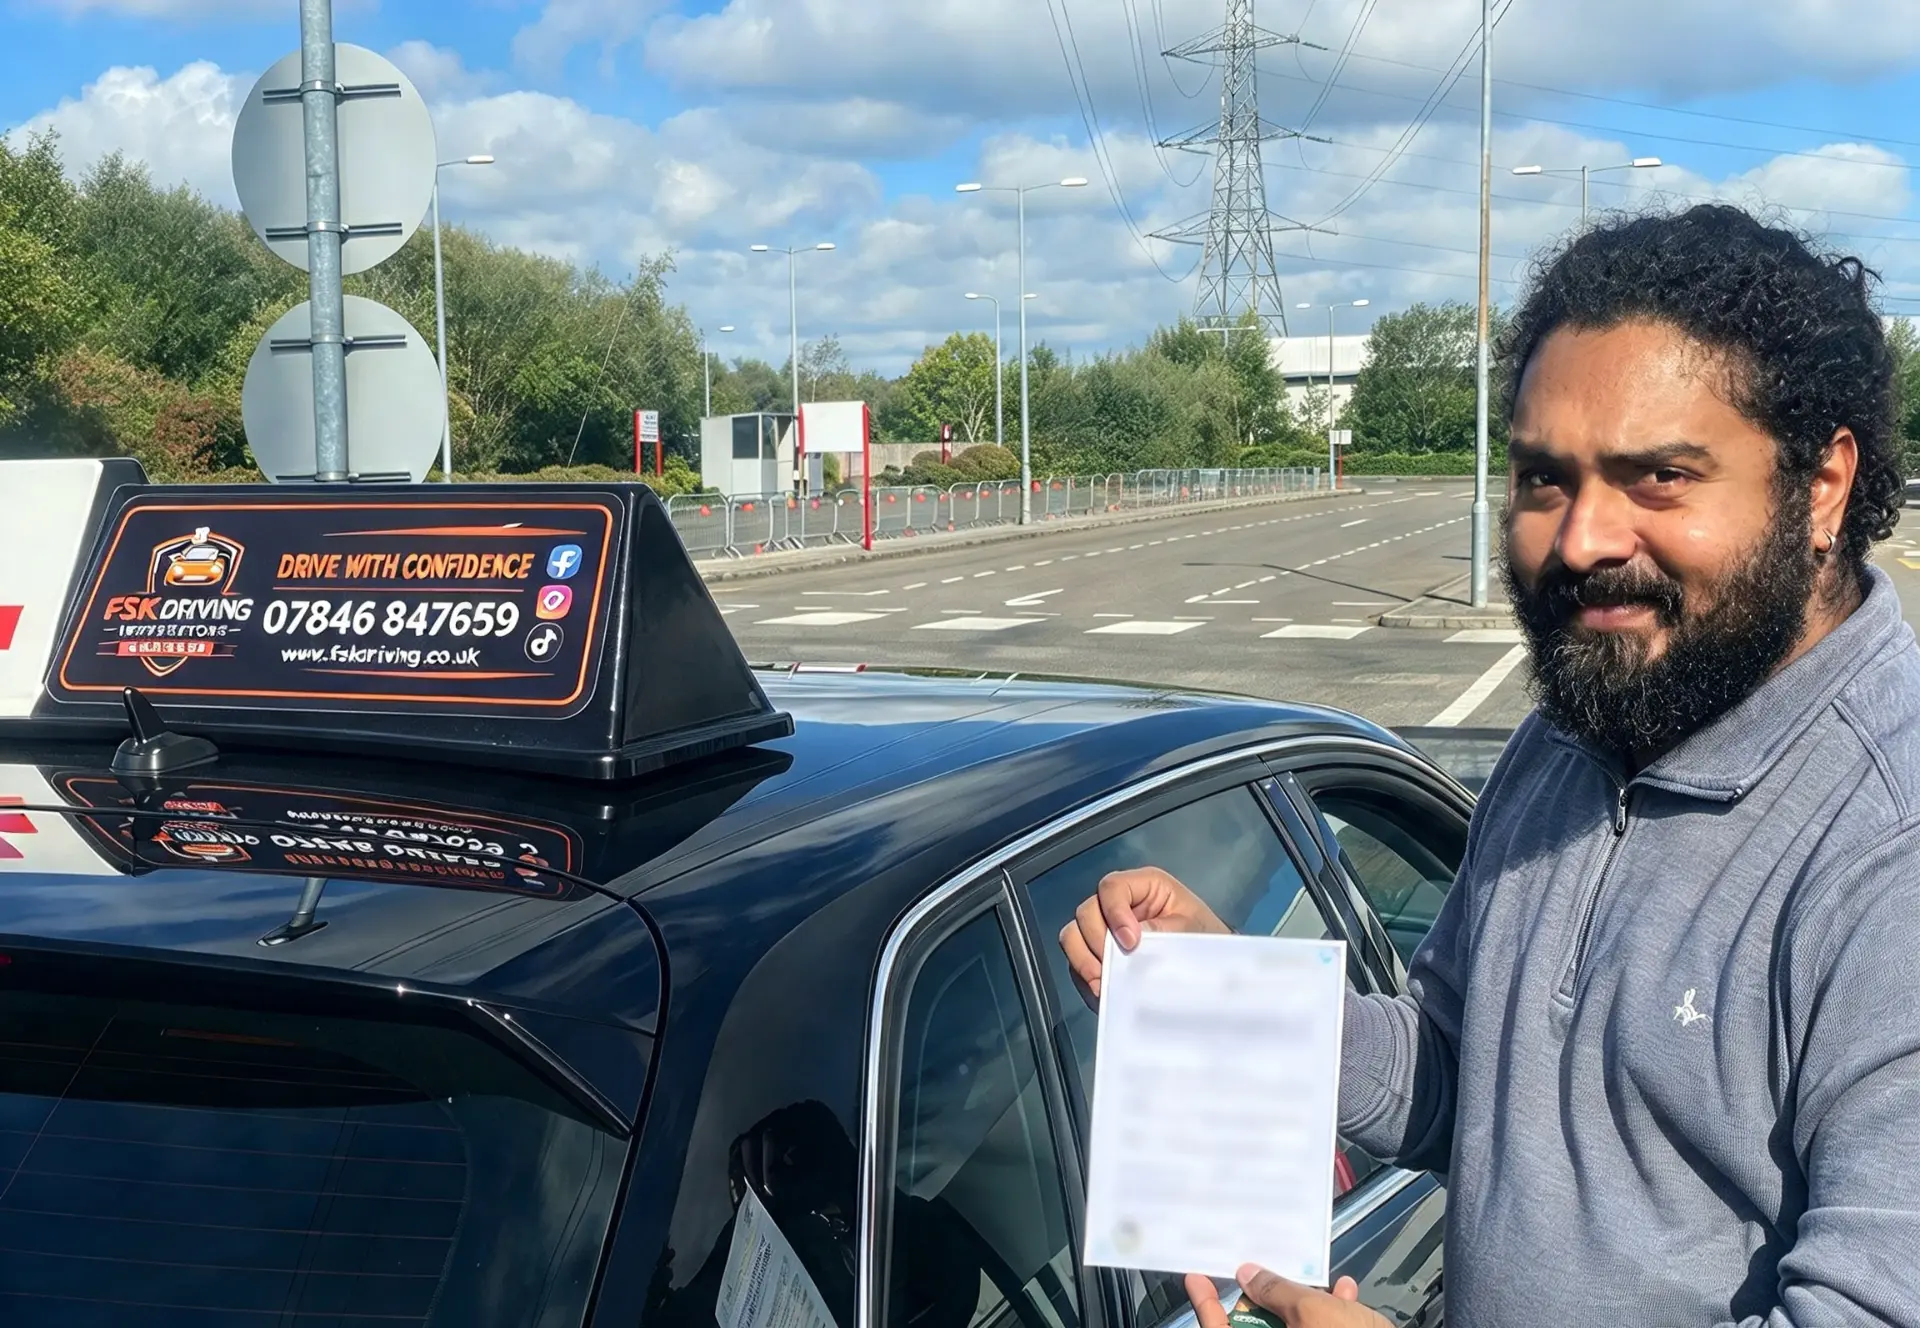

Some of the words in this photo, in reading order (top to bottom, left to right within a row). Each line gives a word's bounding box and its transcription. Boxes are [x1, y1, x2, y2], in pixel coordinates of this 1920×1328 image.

[277, 553, 342, 578] DRIVE
[344, 553, 400, 579] WITH
[402, 553, 535, 580] CONFIDENCE
[103, 597, 162, 620] FSK
[159, 598, 254, 621] DRIVING
[262, 599, 376, 636] 07846
[381, 599, 520, 637] 847659
